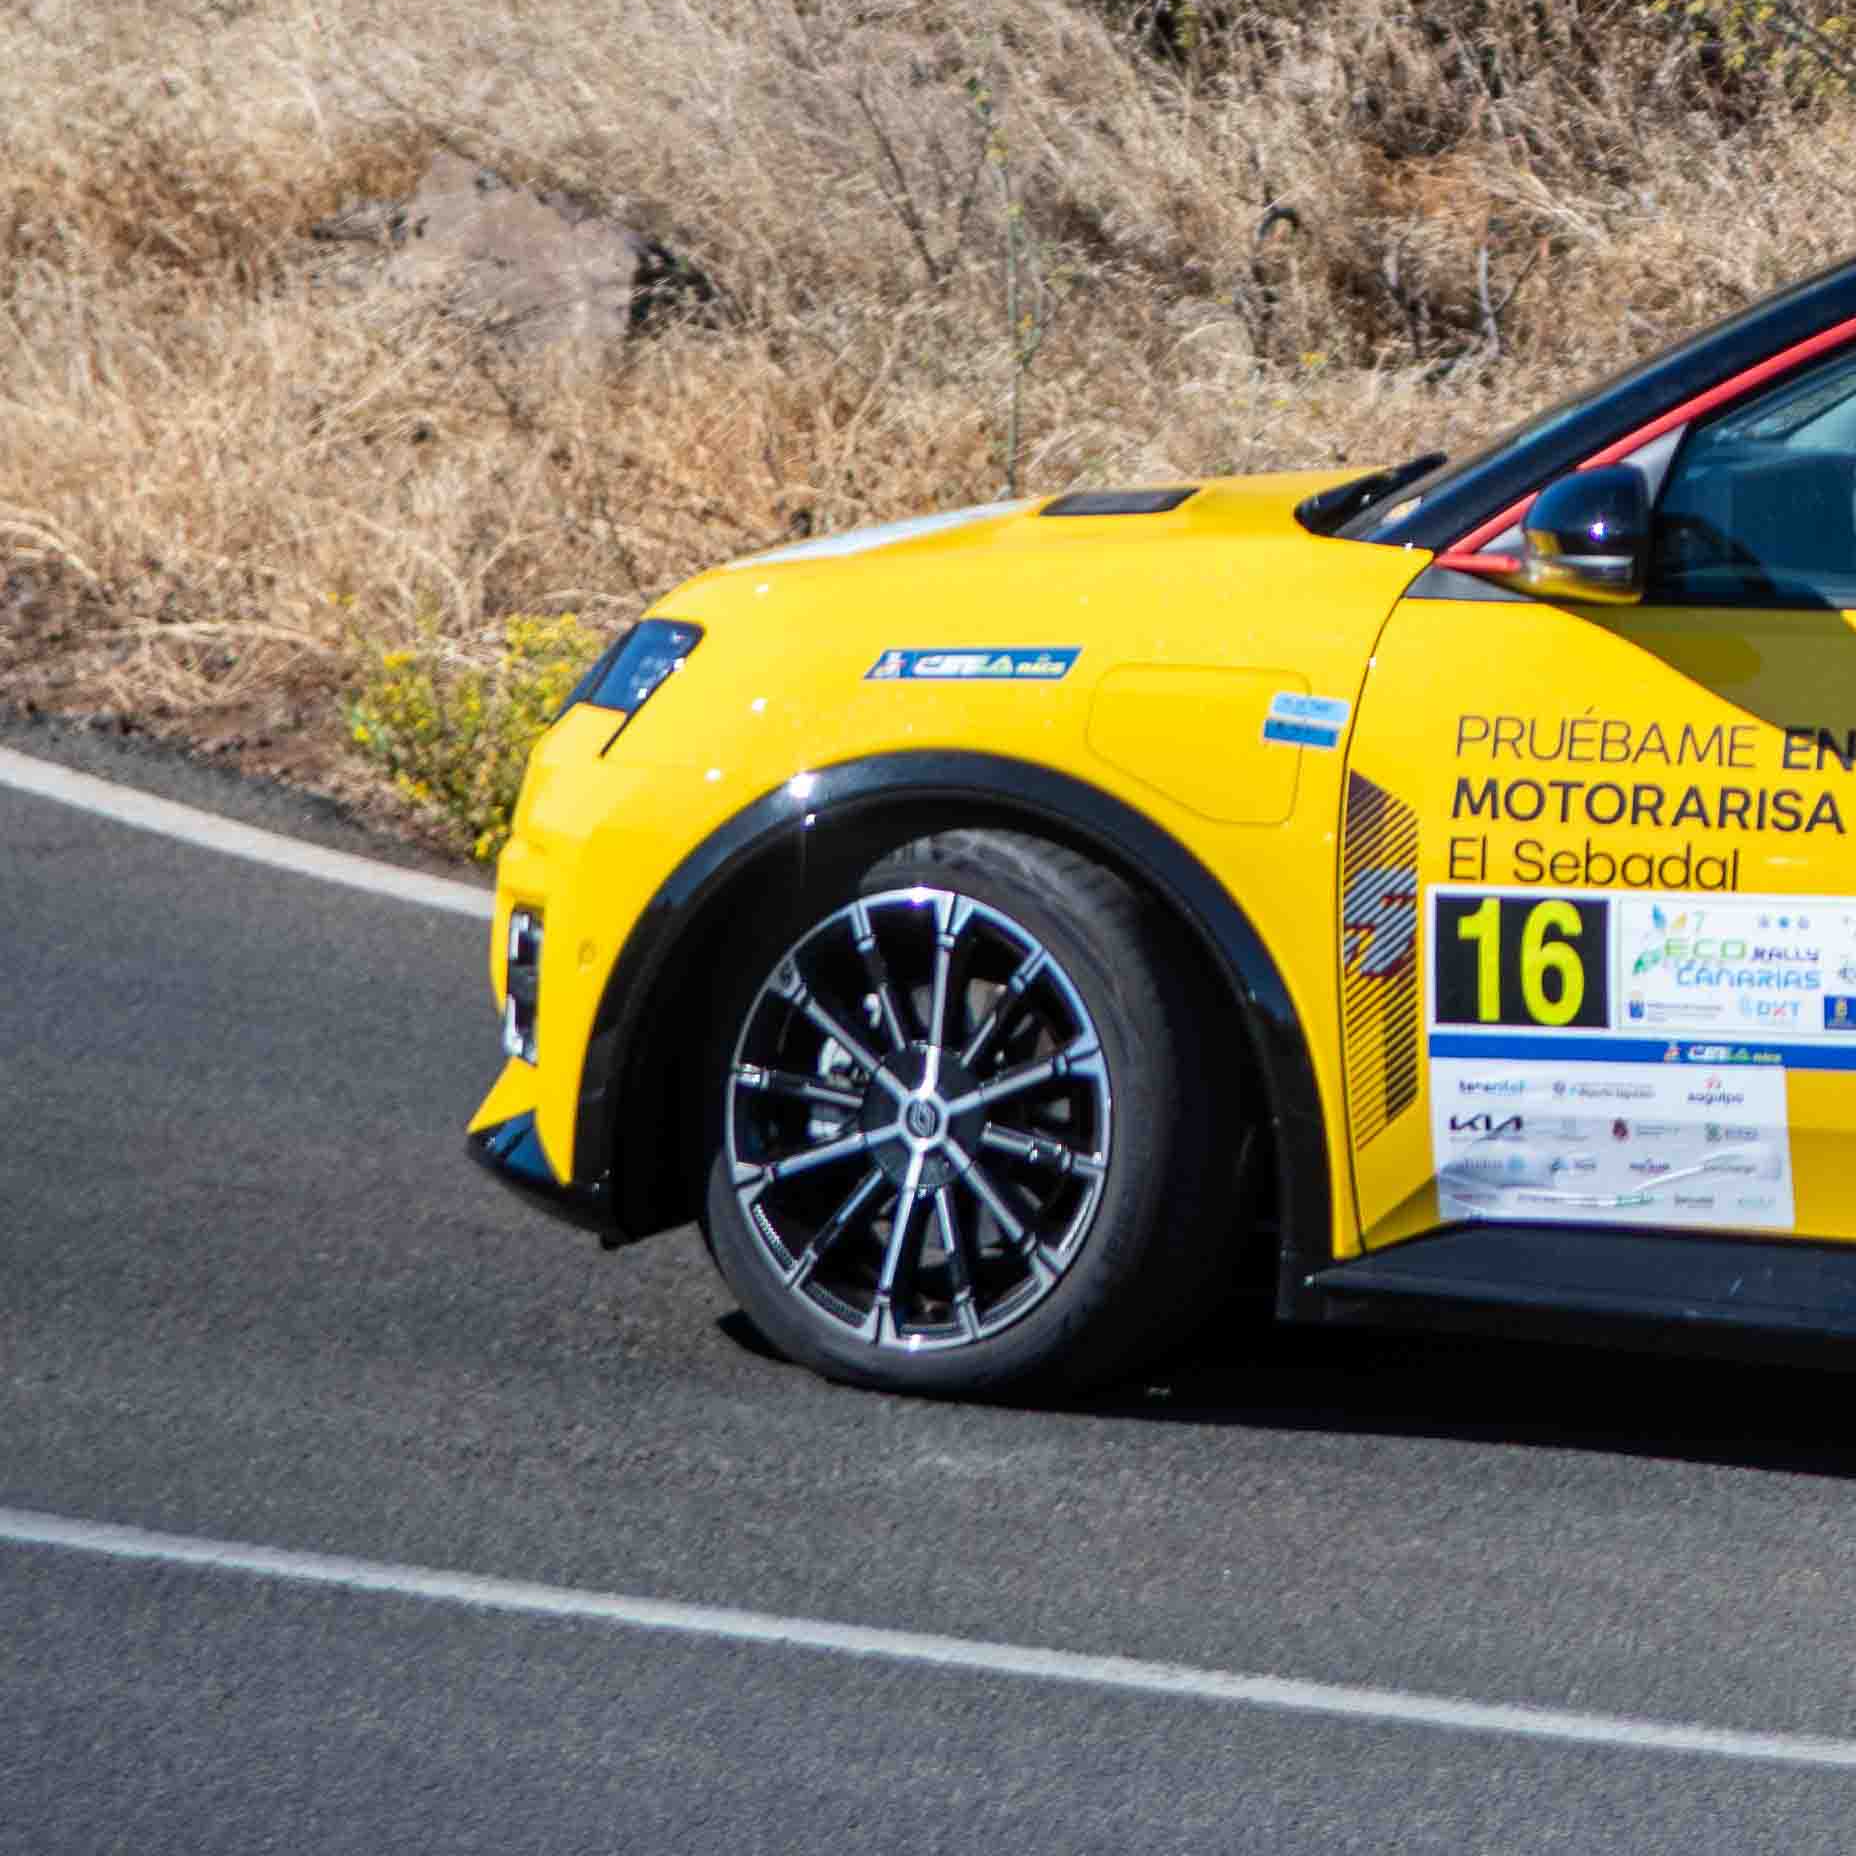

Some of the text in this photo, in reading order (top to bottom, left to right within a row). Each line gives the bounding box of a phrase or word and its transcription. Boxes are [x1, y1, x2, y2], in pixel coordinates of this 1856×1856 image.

[1455, 706, 1759, 769] PRUÉBAME
[1451, 776, 1847, 835] MOTORARISA
[1448, 832, 1740, 892] El Sebadal
[1458, 896, 1585, 1026] 16
[1663, 937, 1820, 963] ECO RALLY
[1676, 964, 1822, 991] CANARIAS
